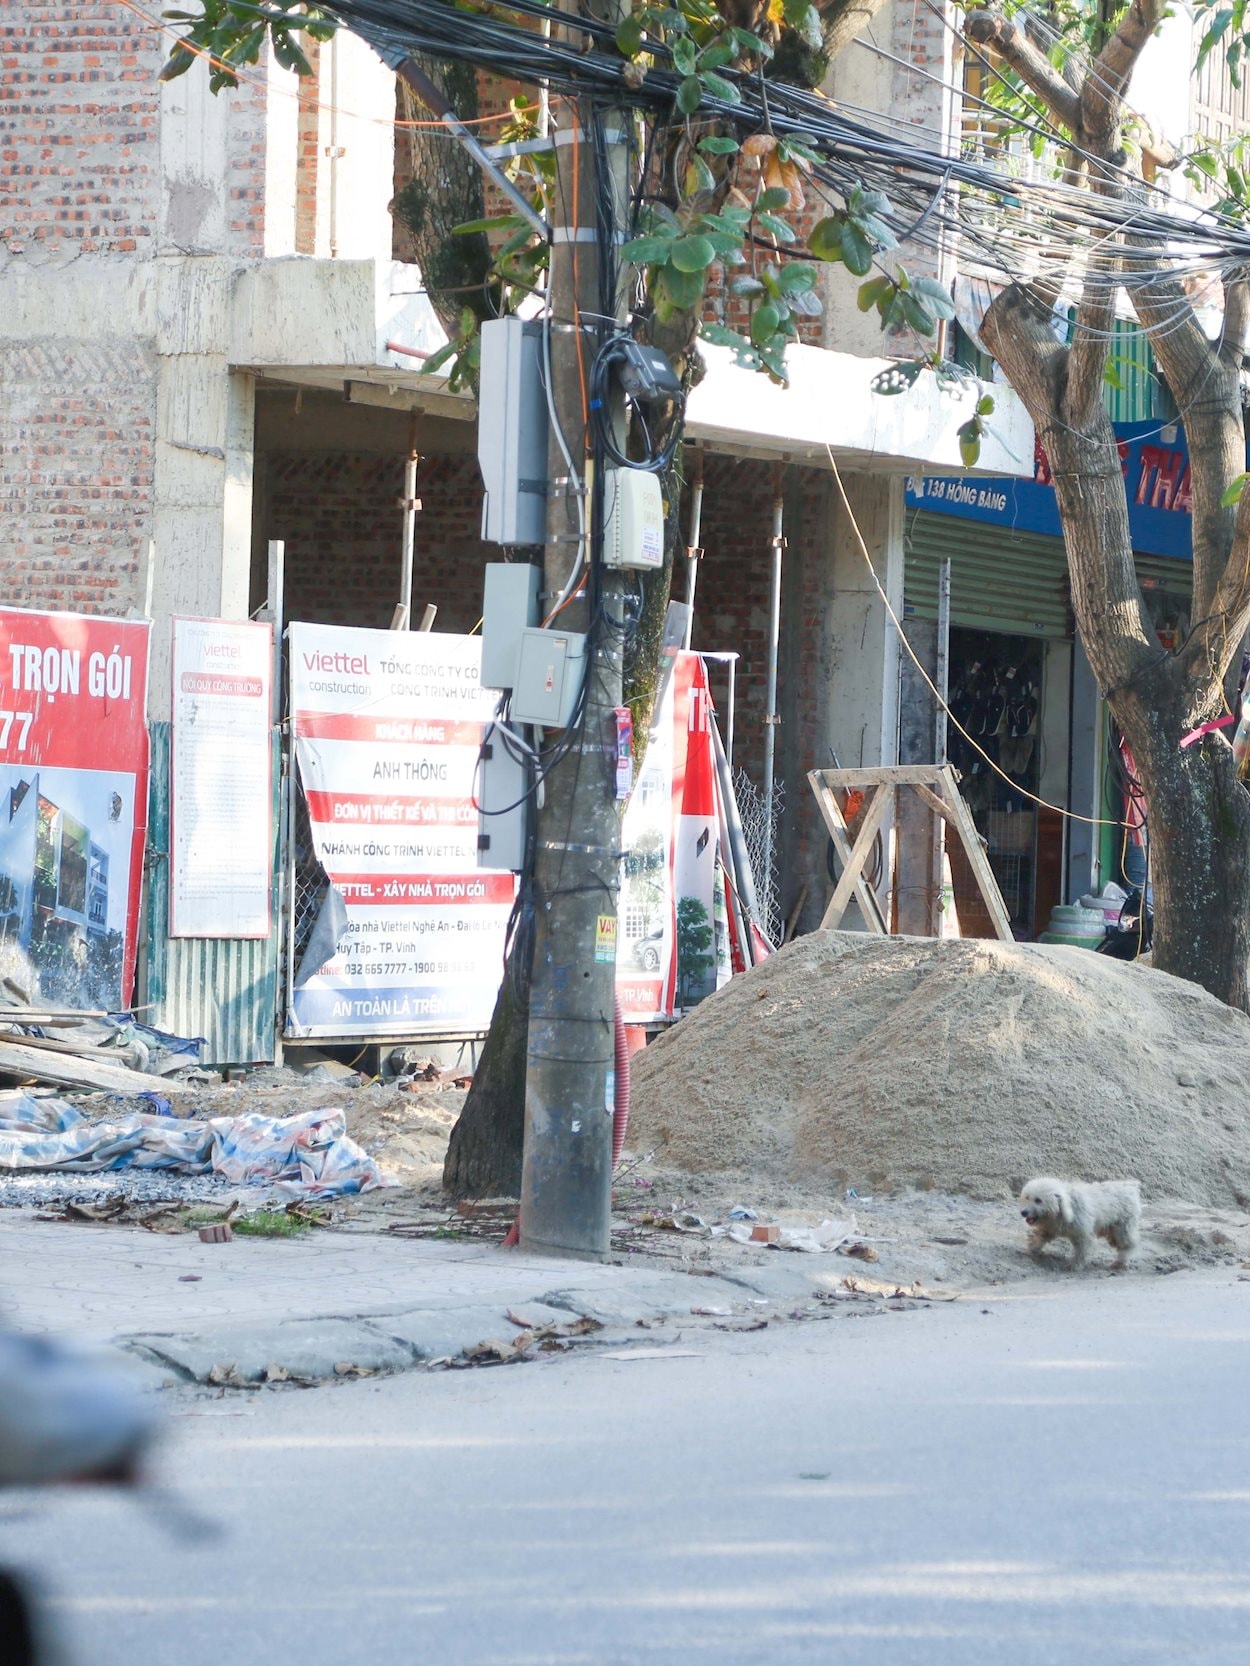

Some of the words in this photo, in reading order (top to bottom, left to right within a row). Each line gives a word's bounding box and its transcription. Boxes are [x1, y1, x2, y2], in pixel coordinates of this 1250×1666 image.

[927, 478, 945, 498] 138
[946, 477, 977, 505] HỒNG
[978, 487, 1007, 511] BÀNG
[203, 643, 242, 658] viettel
[303, 650, 371, 675] viettel
[448, 665, 460, 679] TY
[9, 644, 80, 703] TRỌN
[88, 645, 132, 700] GÓI
[309, 680, 372, 696] construction
[0, 710, 33, 751] 77
[373, 761, 400, 779] ANH
[404, 758, 447, 781] THÔNG
[334, 802, 359, 819] ĐƠN
[422, 801, 438, 821] VÀ
[363, 841, 391, 857] CÔNG
[425, 844, 465, 857] VIETTEL
[383, 879, 407, 897] XÂY
[408, 879, 432, 897] NHÀ
[434, 884, 465, 899] TRỌN
[467, 879, 485, 897] GÓI
[362, 920, 379, 932] nhà
[381, 920, 411, 932] Viettel
[412, 919, 436, 934] Nghệ
[437, 920, 450, 932] An
[397, 941, 416, 953] Vinh
[345, 963, 363, 976] 032
[384, 962, 407, 975] 7777
[414, 961, 436, 974] 1900
[333, 1000, 352, 1017] AN
[354, 996, 391, 1017] TOÀN
[394, 996, 410, 1015] LÀ
